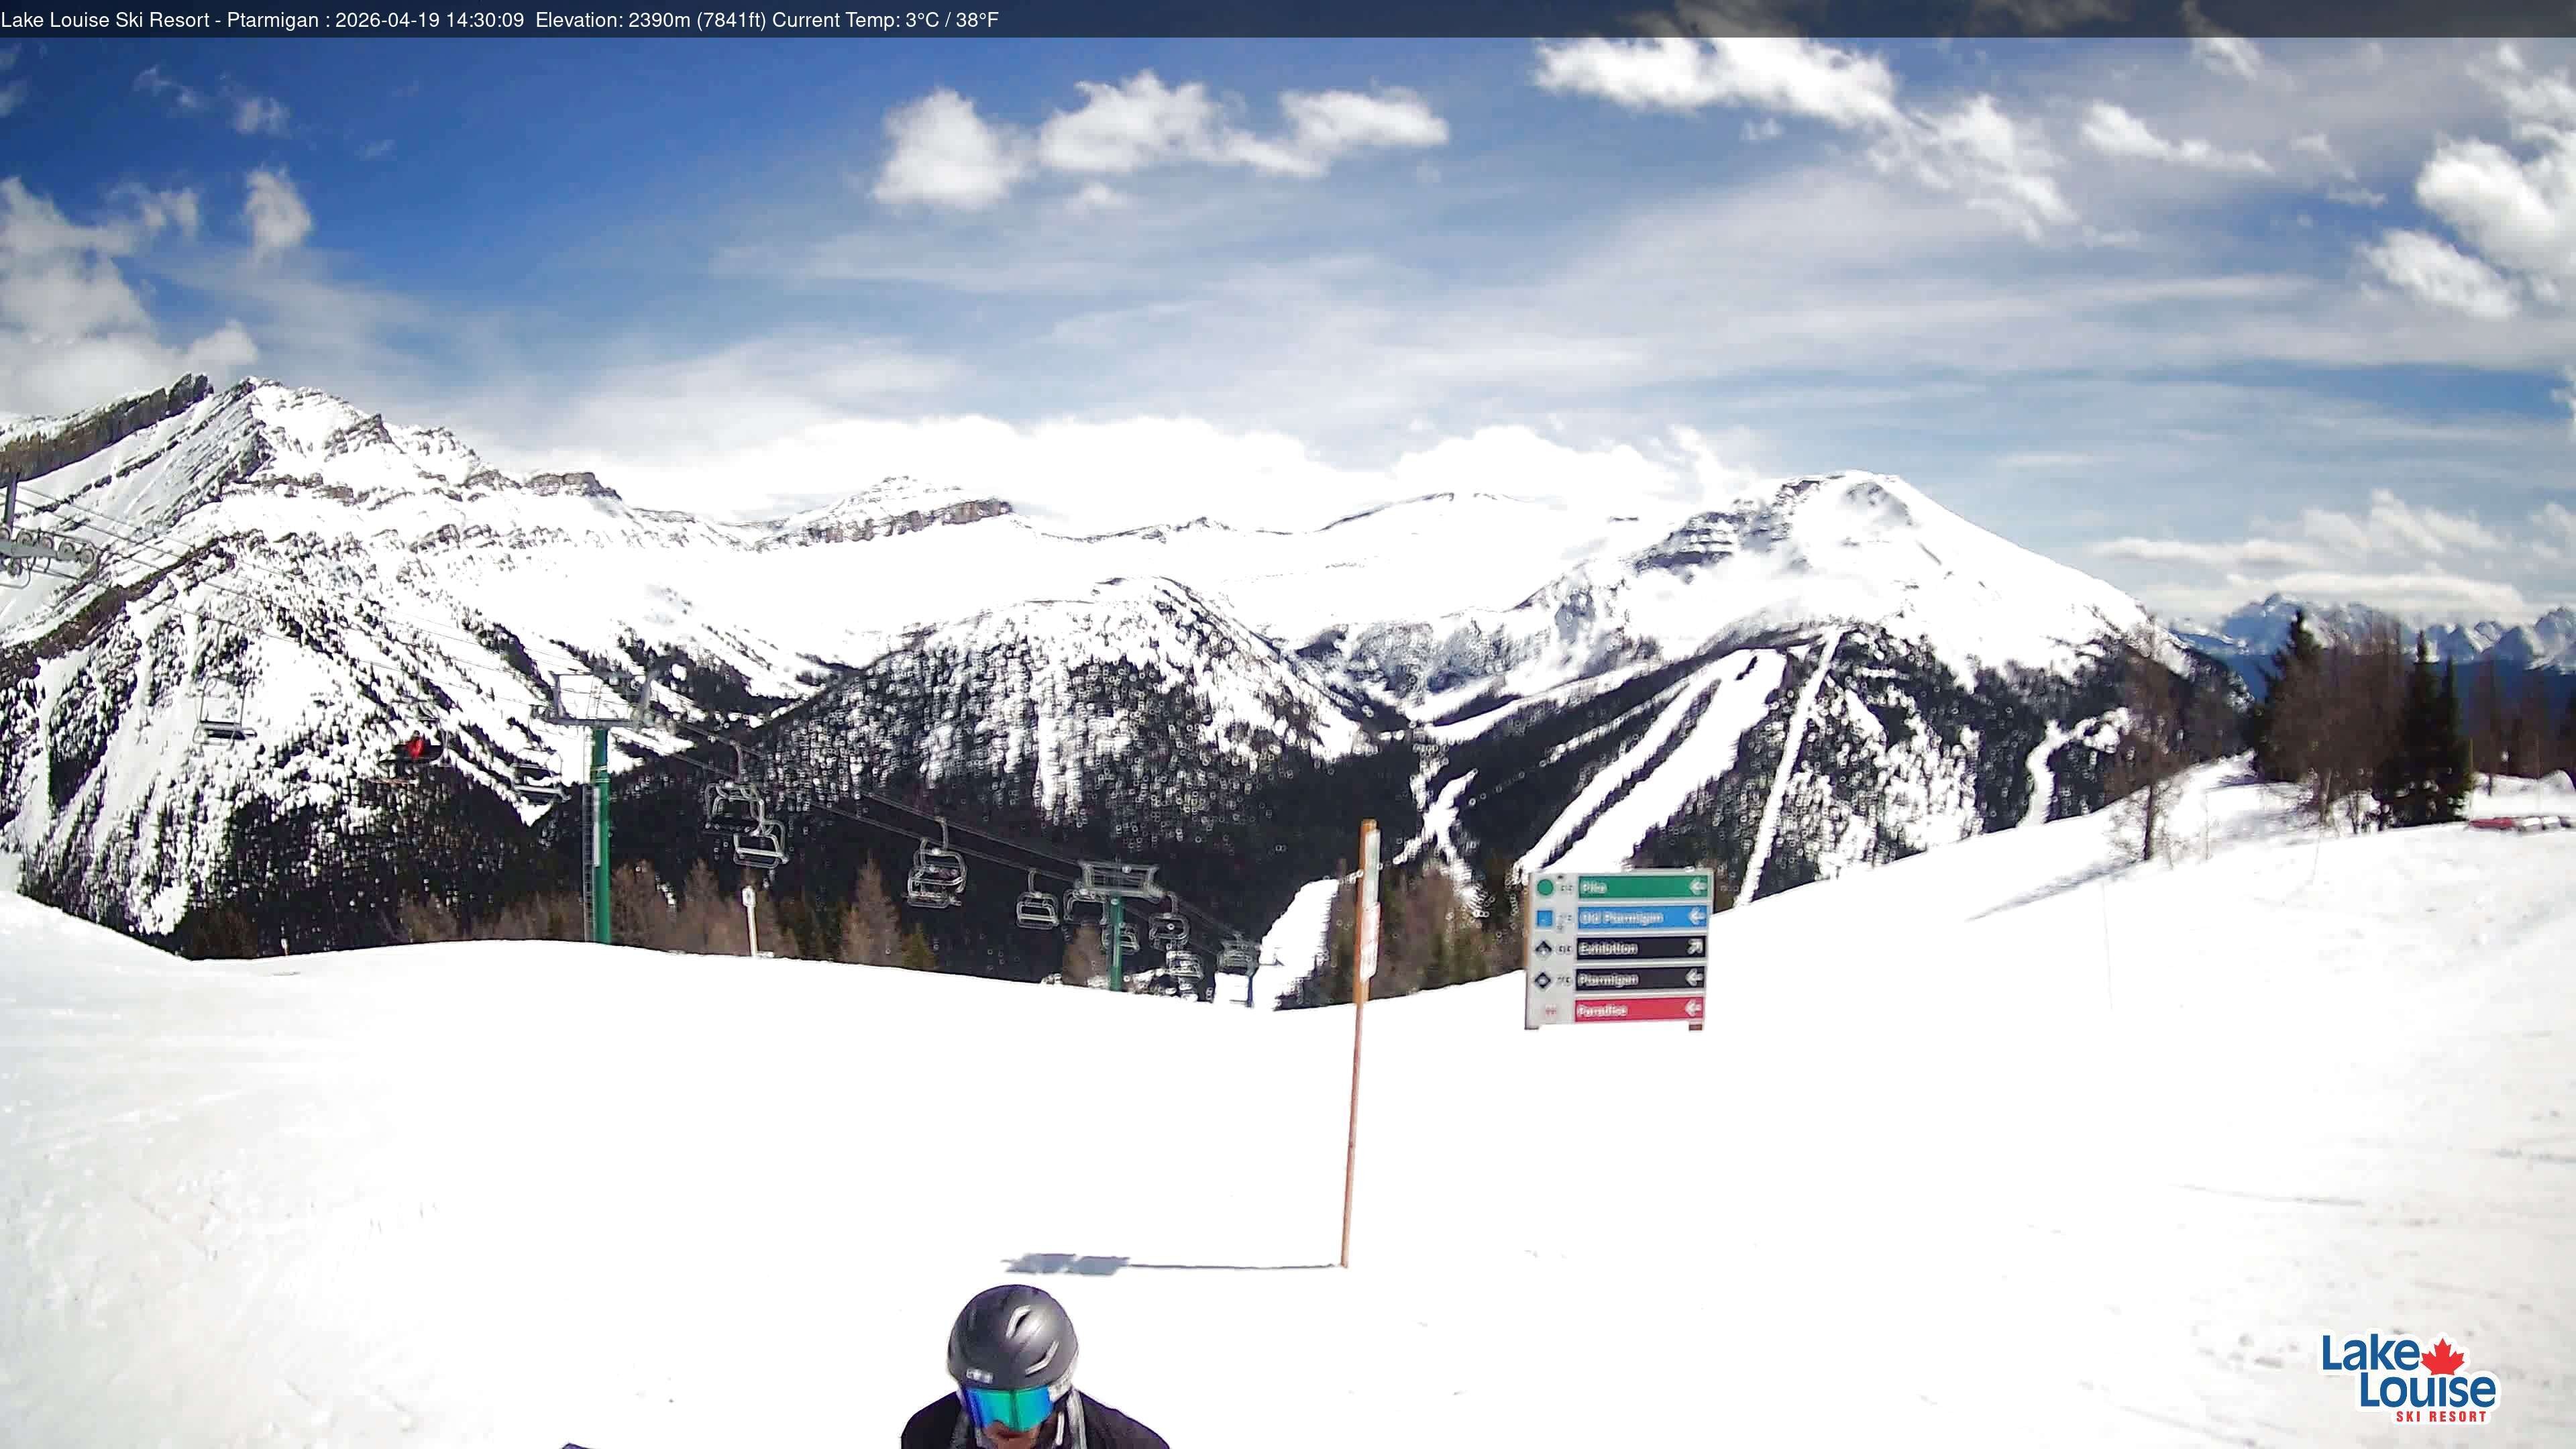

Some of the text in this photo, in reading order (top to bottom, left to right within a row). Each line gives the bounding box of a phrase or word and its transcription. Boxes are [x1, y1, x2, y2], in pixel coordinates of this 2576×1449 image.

[1603, 911, 1664, 926] Ptarmigan
[1578, 942, 1638, 955] Exhibition
[1578, 973, 1639, 987] Ptarmigan
[1577, 1004, 1627, 1016] Paradise
